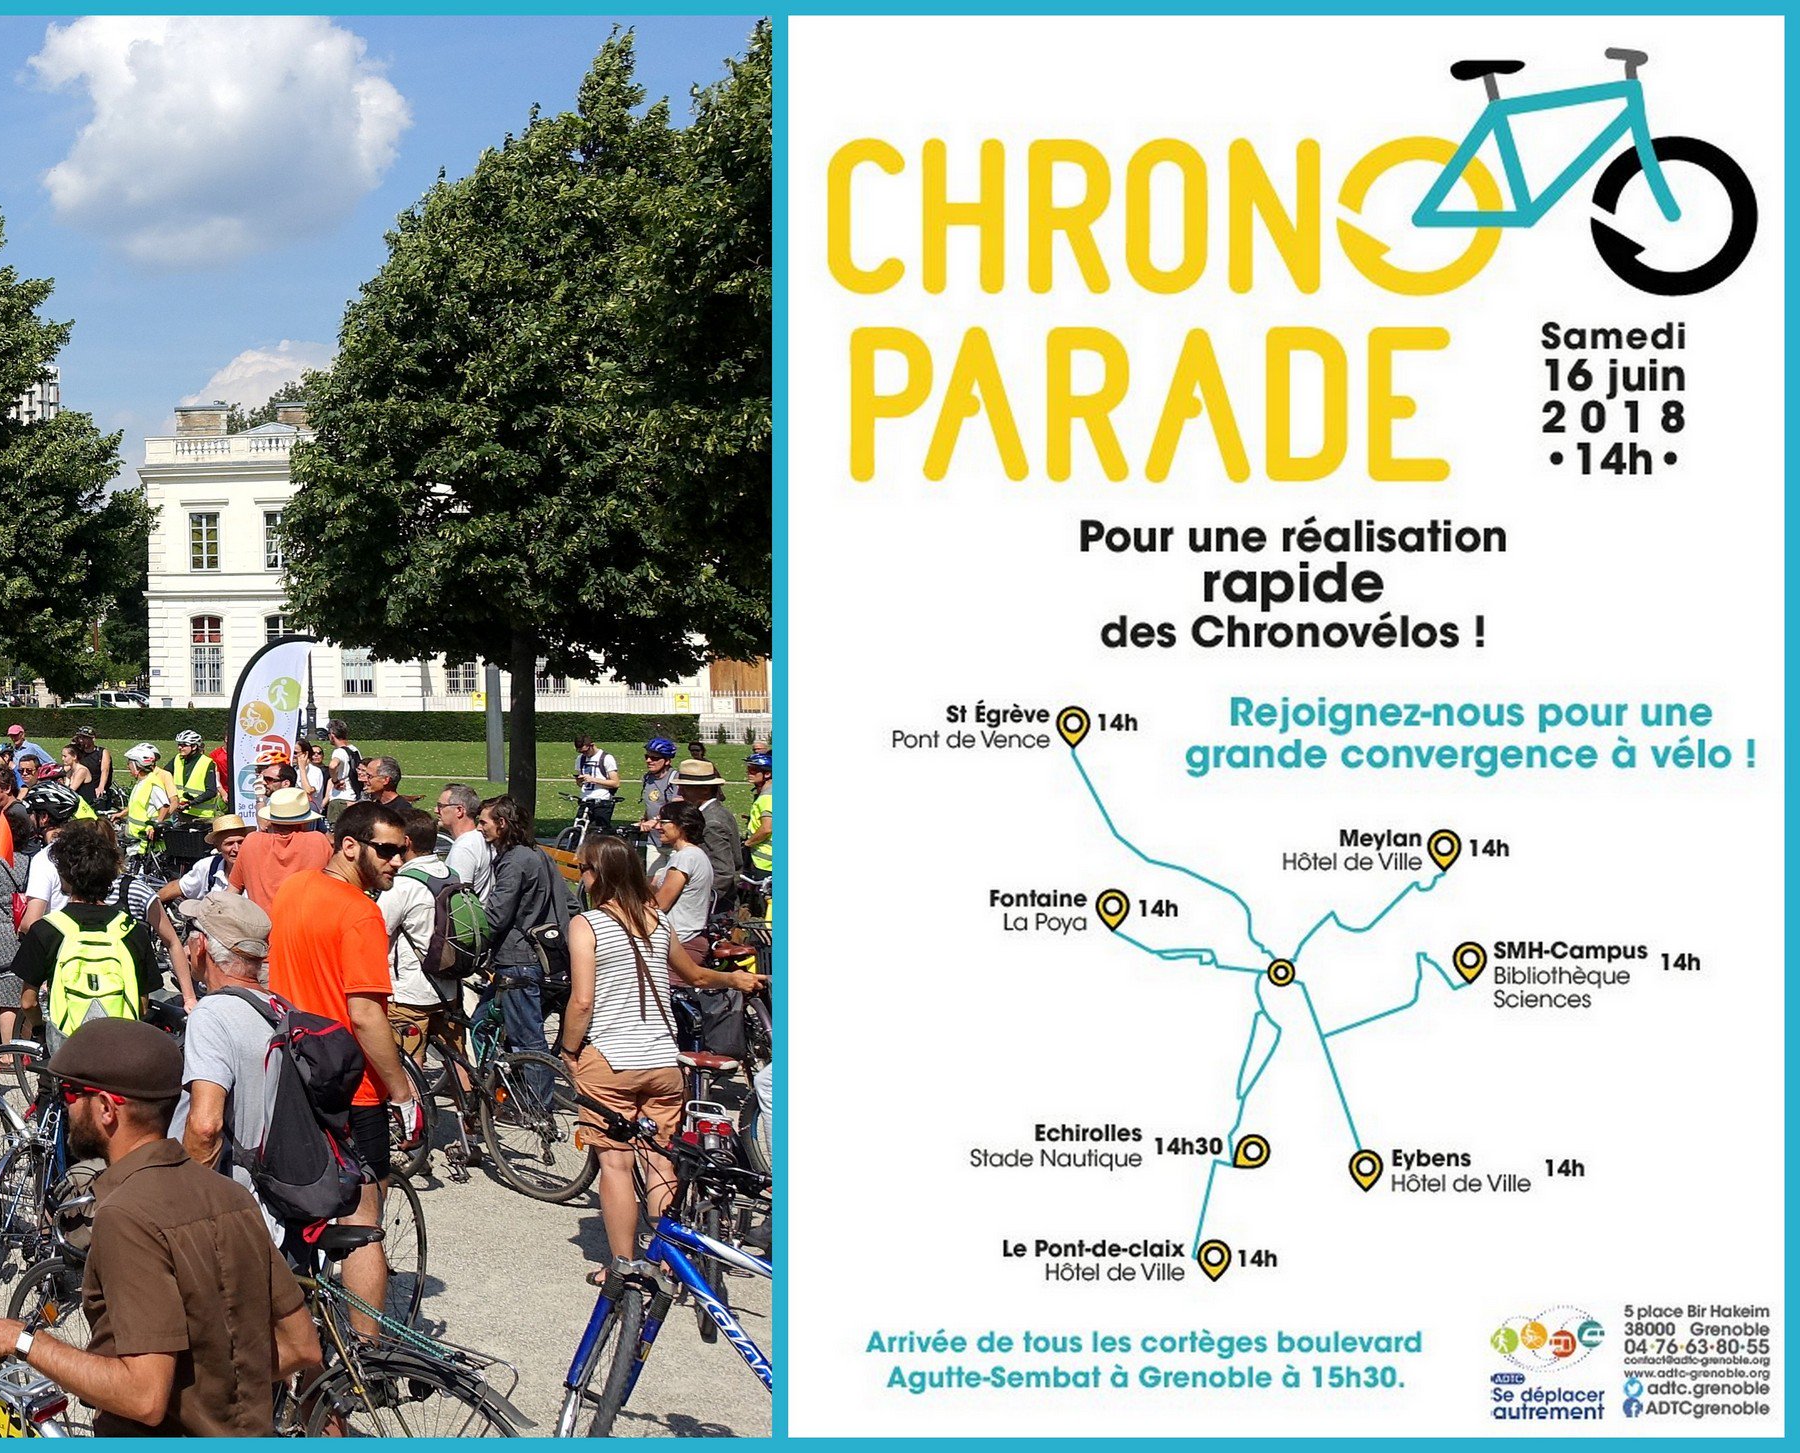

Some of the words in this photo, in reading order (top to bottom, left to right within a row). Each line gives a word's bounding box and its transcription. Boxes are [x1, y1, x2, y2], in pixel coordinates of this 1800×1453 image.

[1541, 322, 1685, 350] Samedi
[1545, 359, 1593, 391] 16
[1606, 359, 1685, 396] juin
[850, 326, 1451, 483] PARADE
[1577, 442, 1652, 475] 14h
[1081, 520, 1174, 552] Pour
[1189, 527, 1266, 553] une
[1283, 516, 1506, 552] réalisation
[1204, 561, 1385, 612] rapide
[1101, 615, 1176, 648] des
[1192, 612, 1459, 648] Chronovélos
[947, 705, 967, 723] St
[976, 700, 1050, 728] Égrève
[1098, 714, 1137, 731] 14h
[1231, 697, 1524, 734] Rejoignez-nous
[1539, 704, 1628, 733] pour
[1641, 703, 1712, 727] une
[893, 730, 939, 748] Pont
[946, 731, 975, 748] de
[981, 731, 1050, 748] Vence
[1186, 739, 1327, 777] grande
[1341, 744, 1598, 777] convergence
[1612, 736, 1636, 768] à
[1651, 735, 1732, 768] vélo
[1340, 829, 1421, 852] Meylan
[1470, 839, 1509, 857] 14h
[1283, 853, 1336, 871] Hôtel
[1344, 853, 1373, 871] de
[1378, 853, 1422, 870] Ville
[990, 890, 1087, 907] Fontaine
[1139, 900, 1178, 917] 14h
[1004, 913, 1027, 931] La
[1036, 913, 1086, 935] Poya
[1494, 942, 1648, 964] SMH-Campus
[1661, 953, 1700, 970] 14h
[1495, 966, 1630, 993] Bibliothèque
[1494, 990, 1591, 1008] Sciences
[1035, 1124, 1142, 1142] Echirolles
[1155, 1137, 1223, 1154] 14h30
[971, 1149, 1033, 1167] Stade
[1041, 1149, 1142, 1171] Nautique
[1392, 1149, 1471, 1171] Eybens
[1546, 1159, 1584, 1176] 14h
[1392, 1174, 1445, 1192] Hôtel
[1453, 1175, 1482, 1192] de
[1487, 1174, 1531, 1192] Ville
[1003, 1240, 1027, 1257] Le
[1035, 1240, 1185, 1257] Pont-de-claix
[1238, 1250, 1277, 1267] 14h
[1046, 1263, 1099, 1281] Hôtel
[1107, 1263, 1136, 1281] de
[1141, 1263, 1184, 1281] Ville
[1625, 1305, 1634, 1317] 5
[1638, 1305, 1683, 1319] place
[1688, 1305, 1706, 1317] Bir
[1711, 1305, 1769, 1317] Hakeim
[1625, 1322, 1675, 1336] 38000
[1690, 1322, 1769, 1336] Grenoble
[866, 1329, 967, 1353] Arrivée
[977, 1331, 1013, 1353] de
[1023, 1331, 1082, 1353] tous
[1093, 1331, 1131, 1353] les
[1141, 1329, 1267, 1359] cortèges
[1278, 1331, 1421, 1353] boulevard
[1624, 1356, 1770, 1367] contact@adtc-grenoble.org
[887, 1366, 1101, 1394] Agutte-Sembat
[1110, 1364, 1128, 1388] à
[1139, 1366, 1272, 1388] Grenoble
[1282, 1365, 1300, 1388] à
[1313, 1366, 1404, 1388] 15h30.
[1493, 1374, 1523, 1384] ADTC
[1624, 1369, 1770, 1381] www.adtc-grenoble.org
[1493, 1389, 1514, 1402] Se
[1521, 1387, 1604, 1405] déplacer
[1648, 1381, 1770, 1396] adtc.grenoble
[1493, 1403, 1605, 1420] autrement
[1646, 1401, 1769, 1417] ADTCgrenoble
